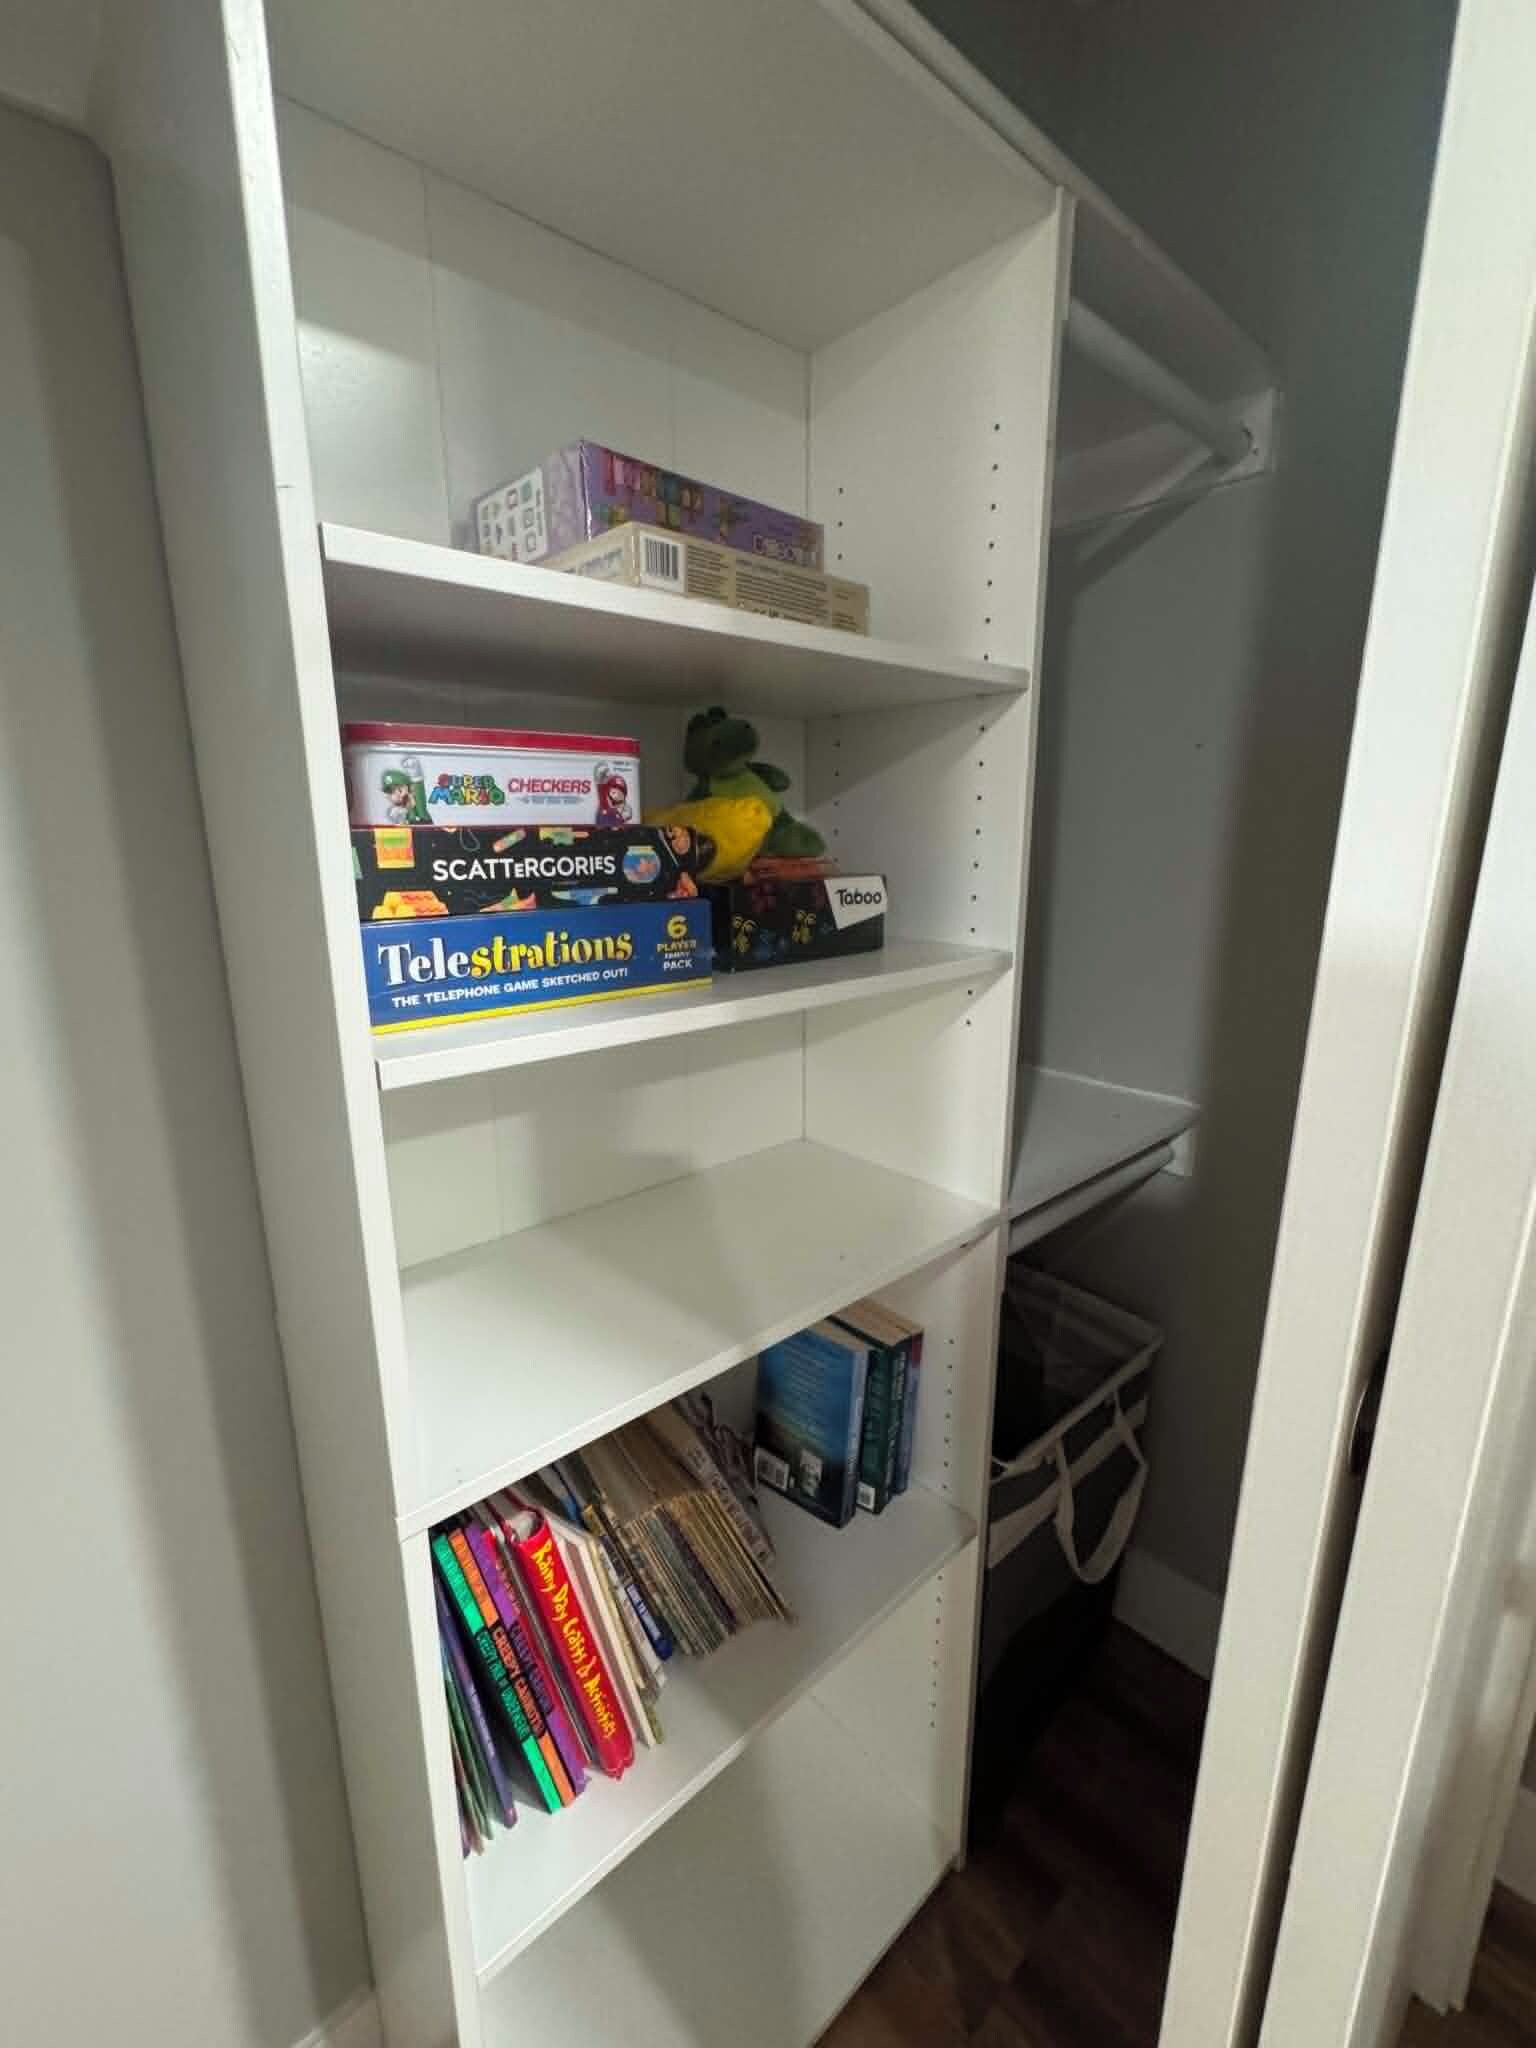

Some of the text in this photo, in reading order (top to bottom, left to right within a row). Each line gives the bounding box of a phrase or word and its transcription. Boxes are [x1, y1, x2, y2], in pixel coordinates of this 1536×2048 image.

[428, 785, 506, 806] MARIO
[508, 779, 592, 794] CHECKERS
[433, 855, 616, 881] SCATTERGORIES
[835, 888, 882, 905] Taboo
[667, 914, 688, 938] 6
[377, 931, 633, 986] Telestrations
[663, 959, 693, 971] PACK
[391, 968, 628, 1008] THE TELEPHONE GAME SKETCHED OUT!
[531, 1538, 556, 1593] Rainy
[552, 1583, 569, 1621] Day
[562, 1617, 588, 1665] Crafts
[583, 1672, 616, 1739] Activities
